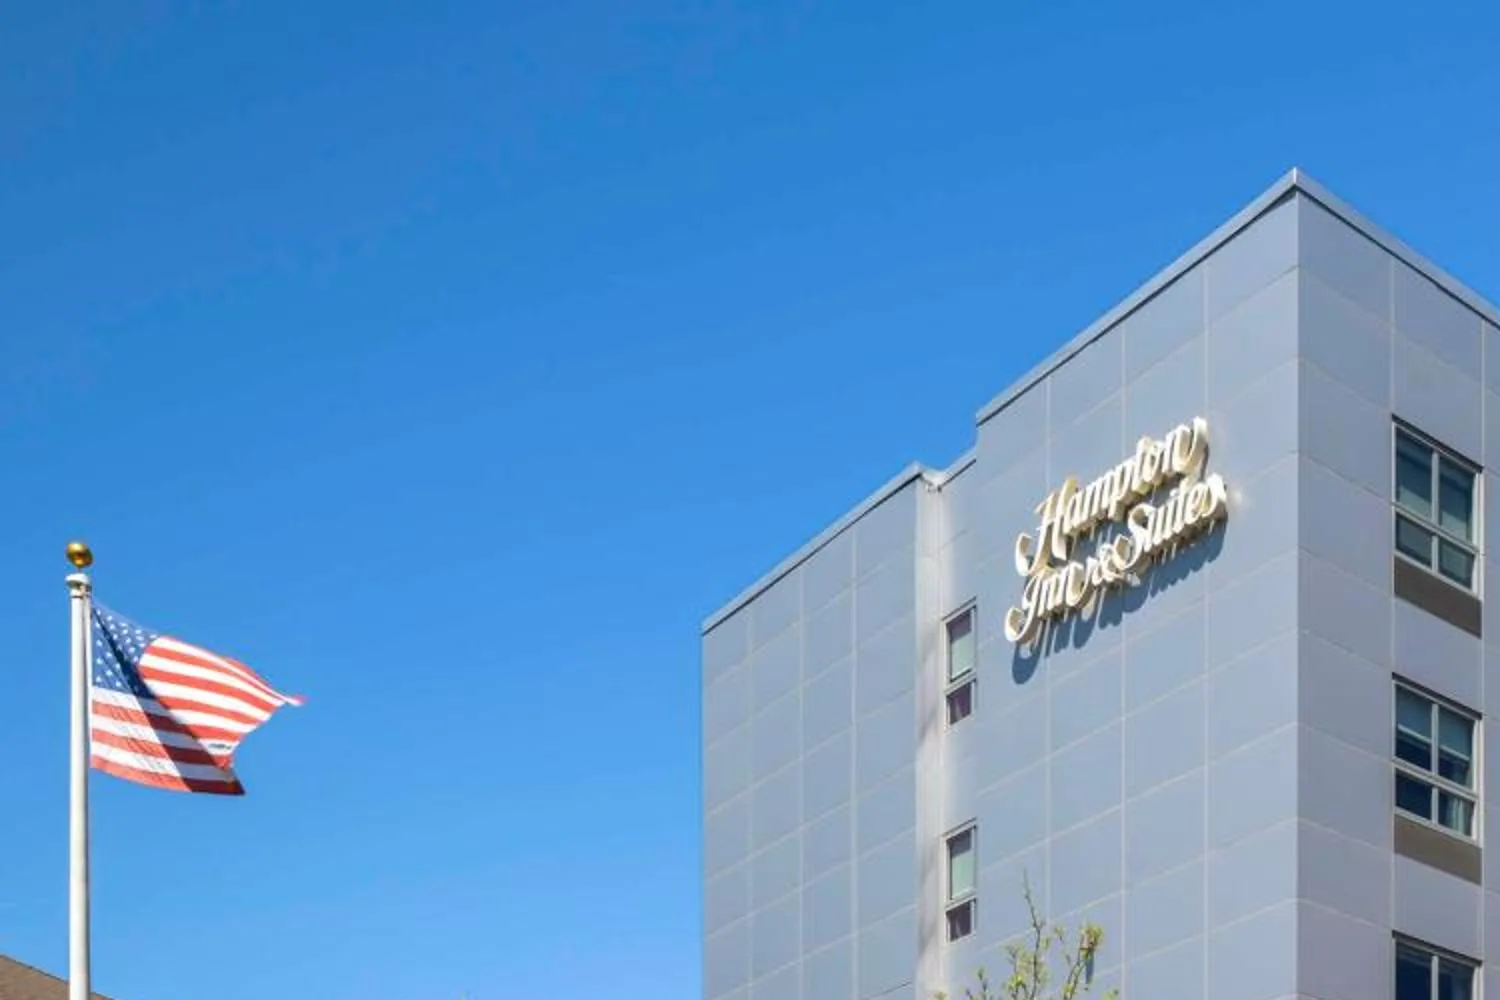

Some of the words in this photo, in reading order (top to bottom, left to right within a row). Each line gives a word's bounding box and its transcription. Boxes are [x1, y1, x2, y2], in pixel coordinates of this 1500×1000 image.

[1004, 556, 1098, 643] Inn
[1112, 472, 1227, 571] Suites
[1015, 415, 1208, 577] Hampton
